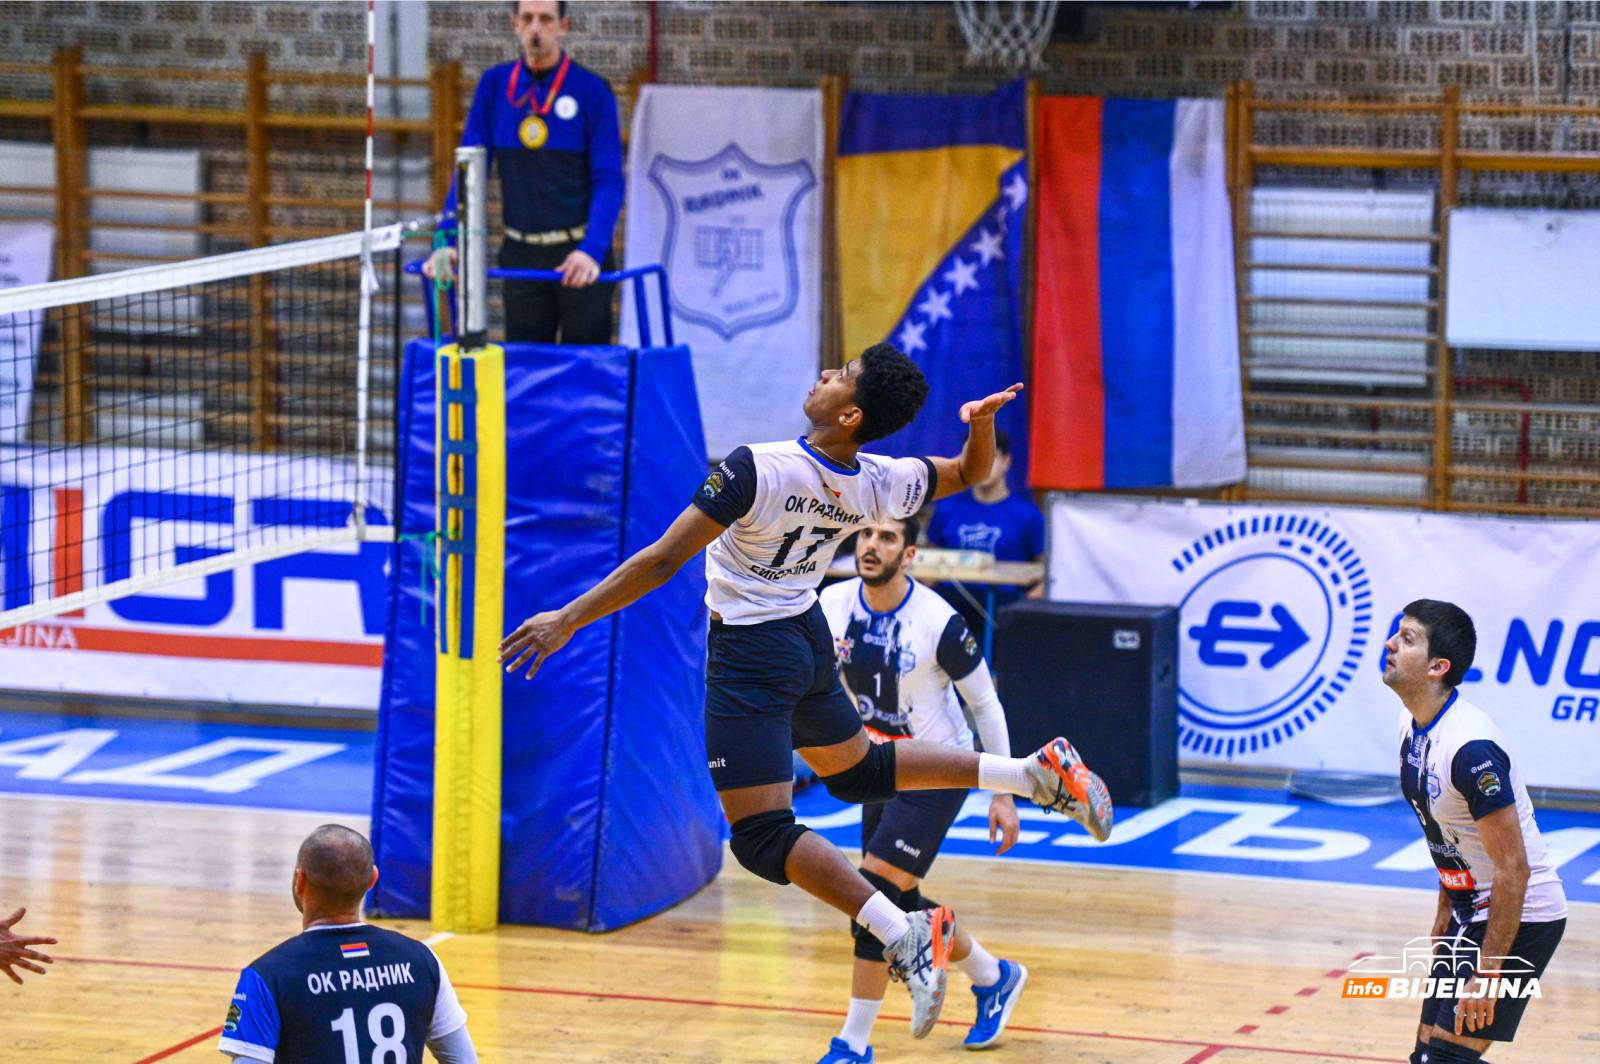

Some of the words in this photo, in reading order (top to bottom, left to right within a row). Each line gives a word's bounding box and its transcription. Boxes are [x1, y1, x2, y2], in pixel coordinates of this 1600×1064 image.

[785, 495, 808, 513] ОК
[807, 498, 865, 525] РАДНИК
[771, 525, 842, 568] 17
[873, 672, 882, 697] 1
[1477, 759, 1493, 771] unit
[903, 844, 921, 858] unit
[307, 972, 337, 995] ОК
[339, 962, 415, 993] РАДНИК
[330, 1002, 408, 1064] 18
